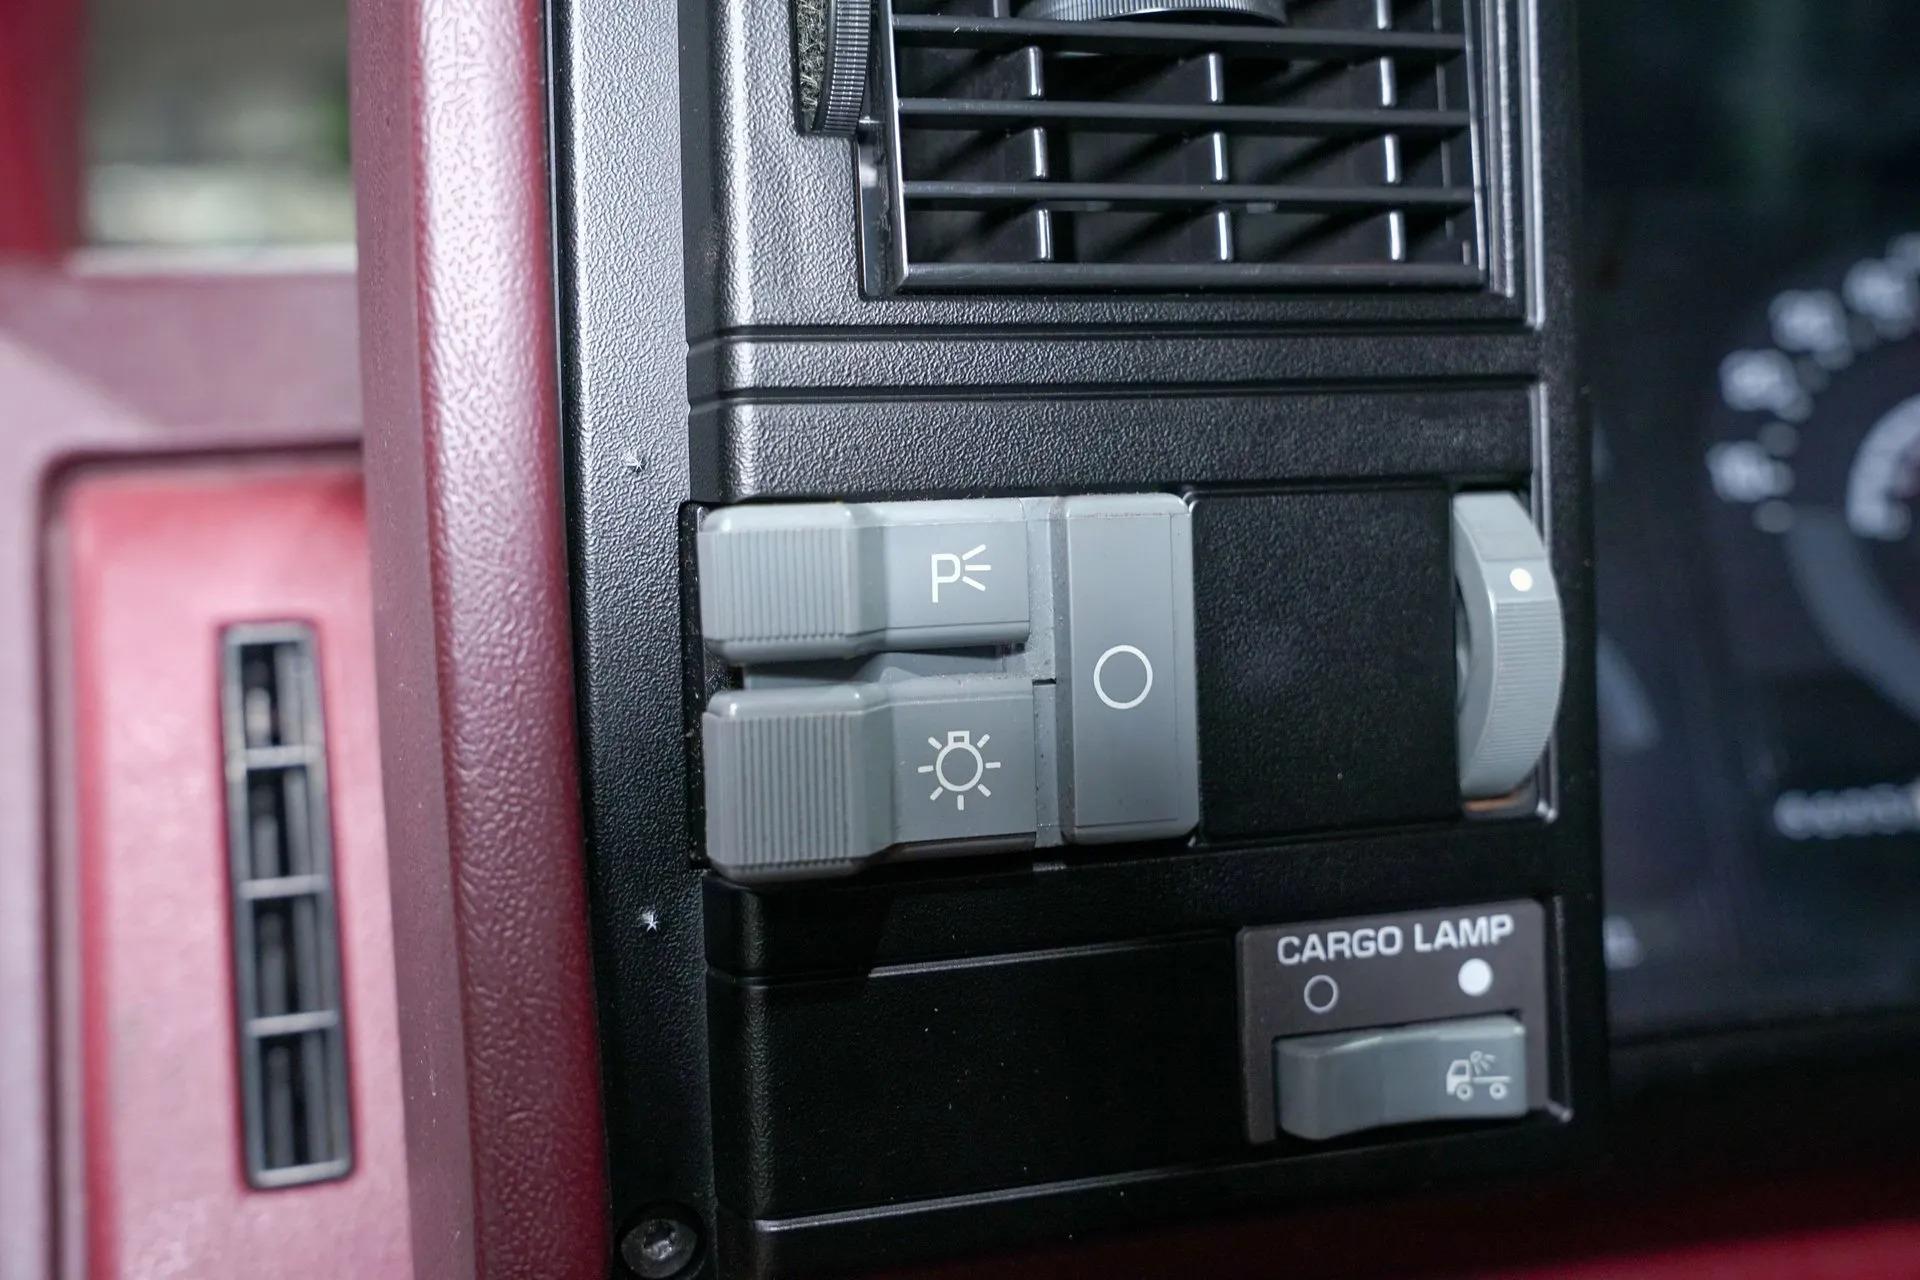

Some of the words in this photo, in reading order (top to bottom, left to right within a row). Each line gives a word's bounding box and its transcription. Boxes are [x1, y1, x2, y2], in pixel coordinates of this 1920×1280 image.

[931, 553, 961, 603] P
[1277, 926, 1403, 966] CARGO
[1414, 914, 1515, 953] LAMP
